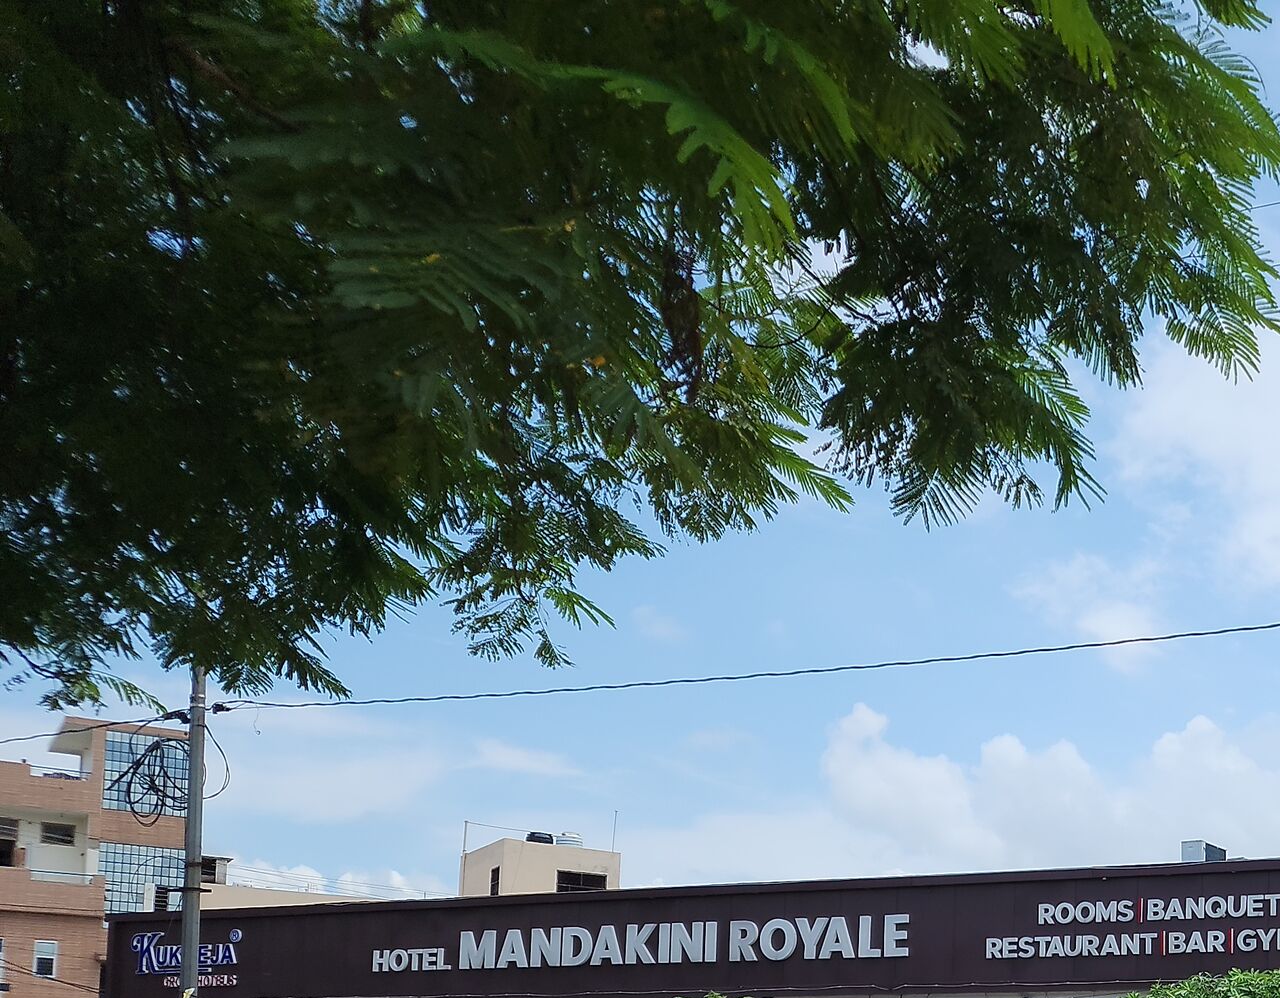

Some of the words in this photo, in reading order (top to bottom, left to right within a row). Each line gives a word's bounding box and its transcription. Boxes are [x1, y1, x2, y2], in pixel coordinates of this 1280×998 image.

[1037, 900, 1135, 925] ROOMS
[131, 931, 237, 975] KUKEJA
[371, 948, 452, 973] HOTEL
[458, 920, 718, 971] MANDAKINI
[727, 913, 911, 964] ROYALE
[984, 932, 1158, 959] RESTAURANT
[1168, 930, 1226, 955] BAR
